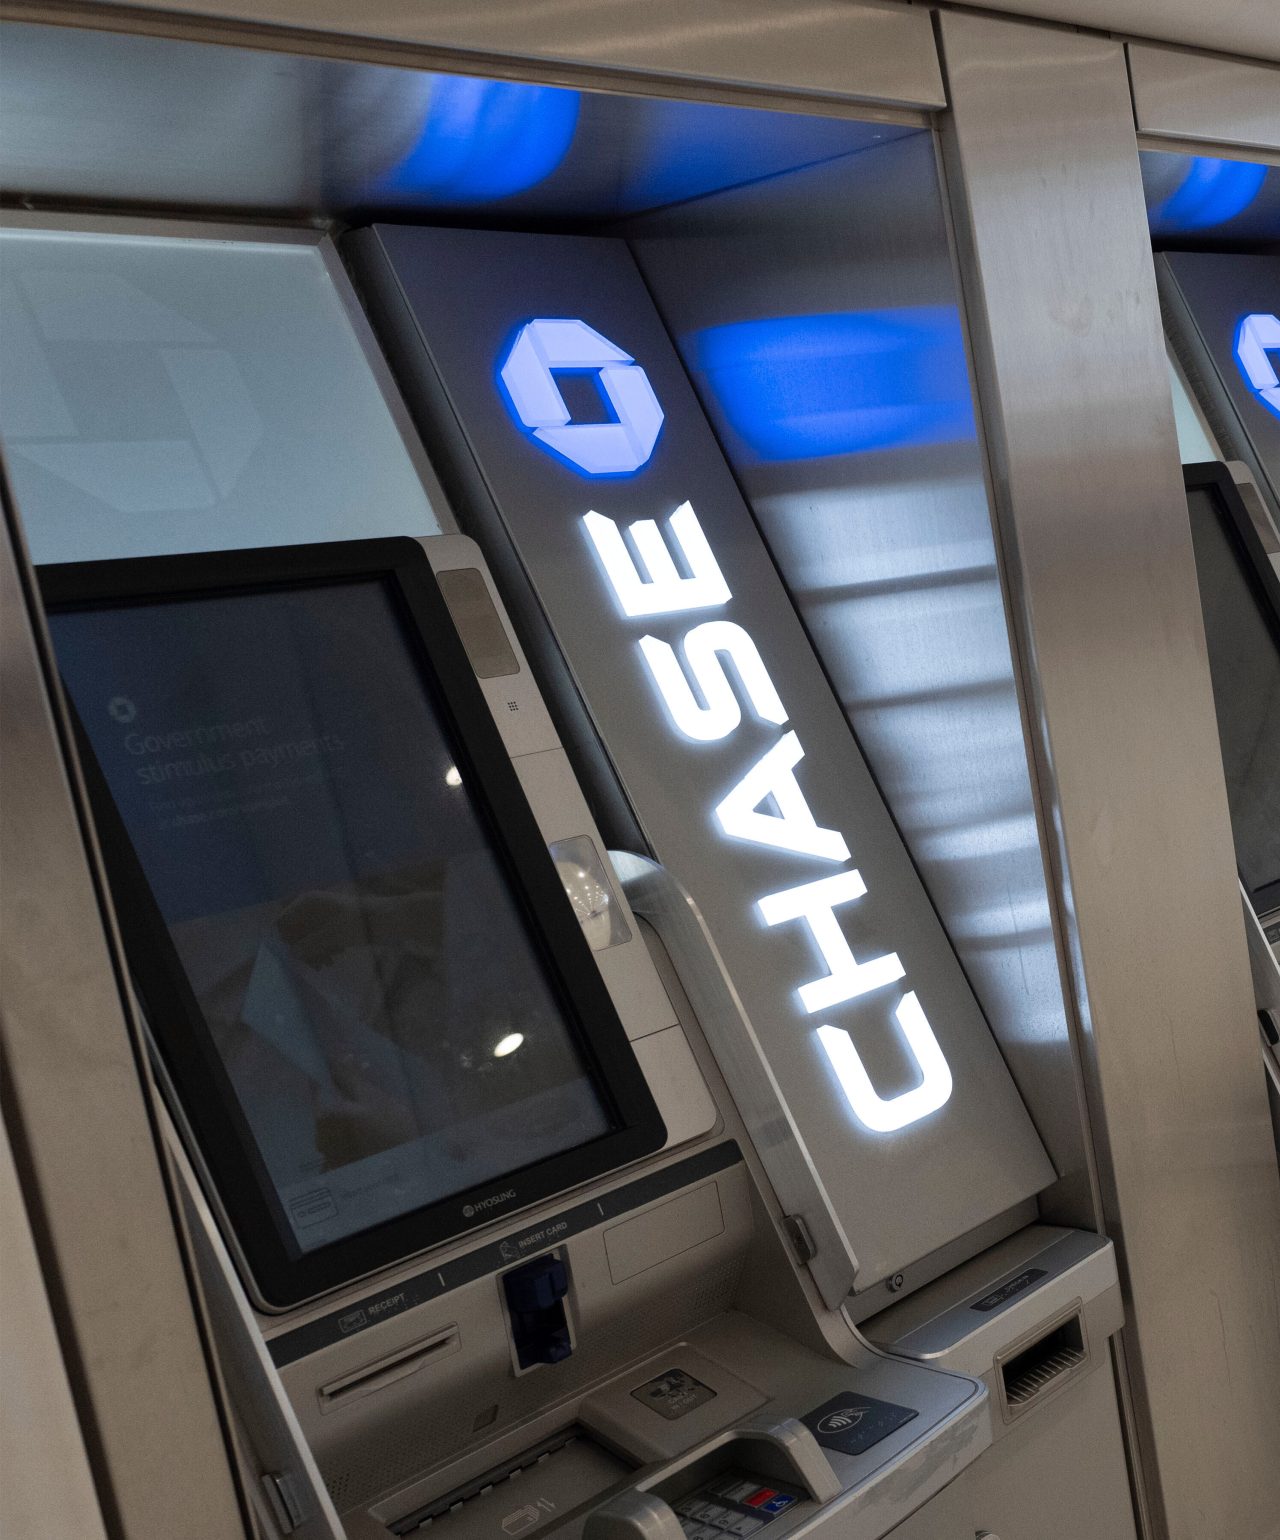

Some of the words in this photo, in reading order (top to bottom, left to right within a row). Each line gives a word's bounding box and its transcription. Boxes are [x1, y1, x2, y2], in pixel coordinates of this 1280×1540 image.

[124, 715, 273, 756] Government
[136, 752, 237, 786] stimulus
[239, 733, 345, 771] payments
[580, 499, 953, 1133] CHASE
[473, 1188, 518, 1214] HYOSUNG
[518, 1231, 547, 1251] INSERT
[545, 1220, 569, 1241] CARD
[367, 1291, 406, 1317] RECEIPT
